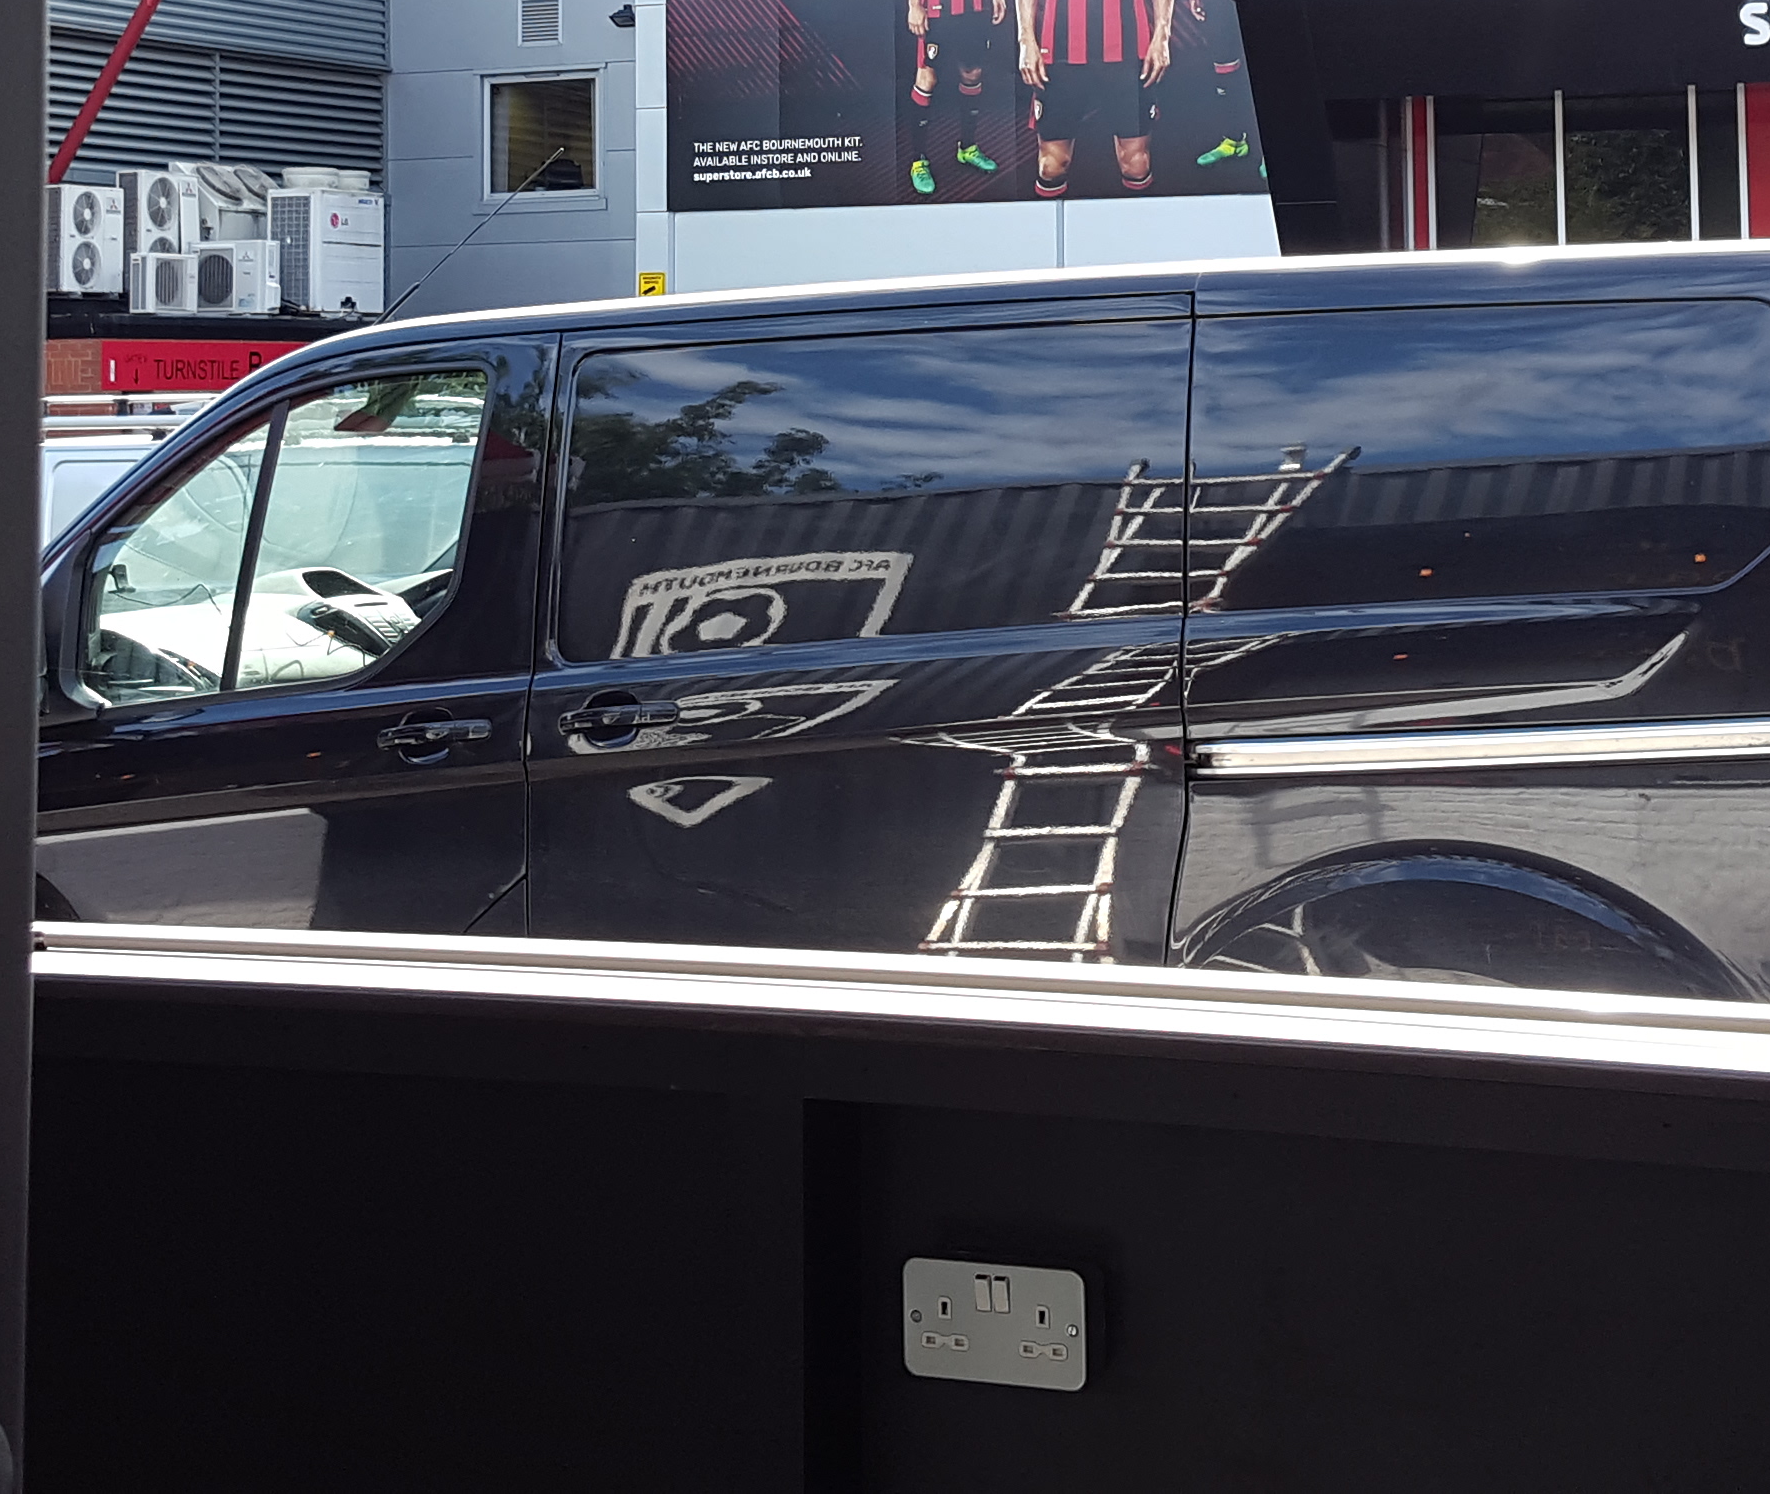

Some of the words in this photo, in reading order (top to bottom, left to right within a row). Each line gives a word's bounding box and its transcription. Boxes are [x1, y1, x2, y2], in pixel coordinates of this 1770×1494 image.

[693, 142, 714, 153] THE
[715, 141, 738, 152] NEW
[739, 140, 761, 151] AFC
[762, 137, 842, 151] BOURNEMOUTH
[844, 136, 863, 148] KIT.
[693, 155, 749, 167] AVAILABLE
[750, 153, 795, 165] INSTORE
[796, 152, 819, 164] AND
[820, 151, 862, 163] ONLINE.
[693, 167, 812, 183] superstore.afcb.co.uk
[153, 358, 241, 381] TURNSTILE
